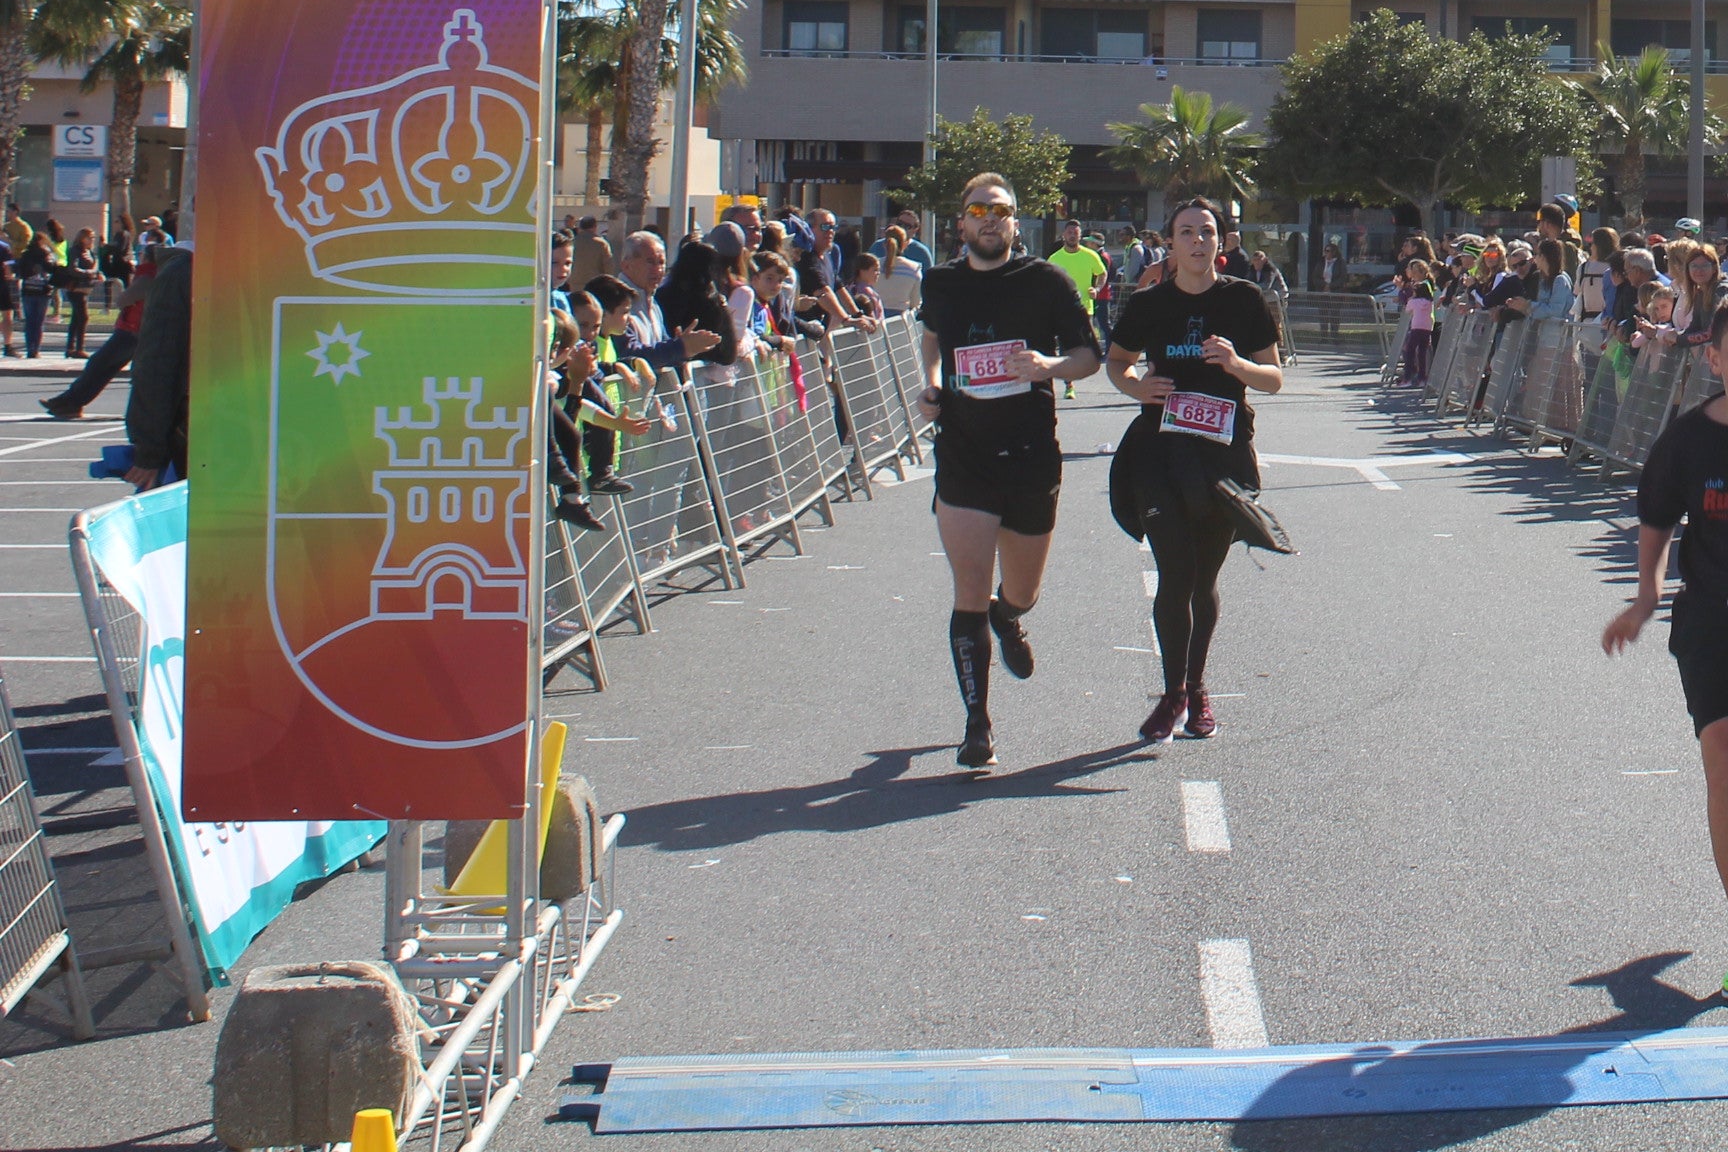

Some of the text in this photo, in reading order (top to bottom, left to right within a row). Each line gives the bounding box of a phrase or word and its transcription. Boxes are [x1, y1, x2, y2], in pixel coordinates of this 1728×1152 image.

[65, 126, 94, 145] CS
[1166, 345, 1203, 357] DAYR
[1182, 405, 1217, 425] 682
